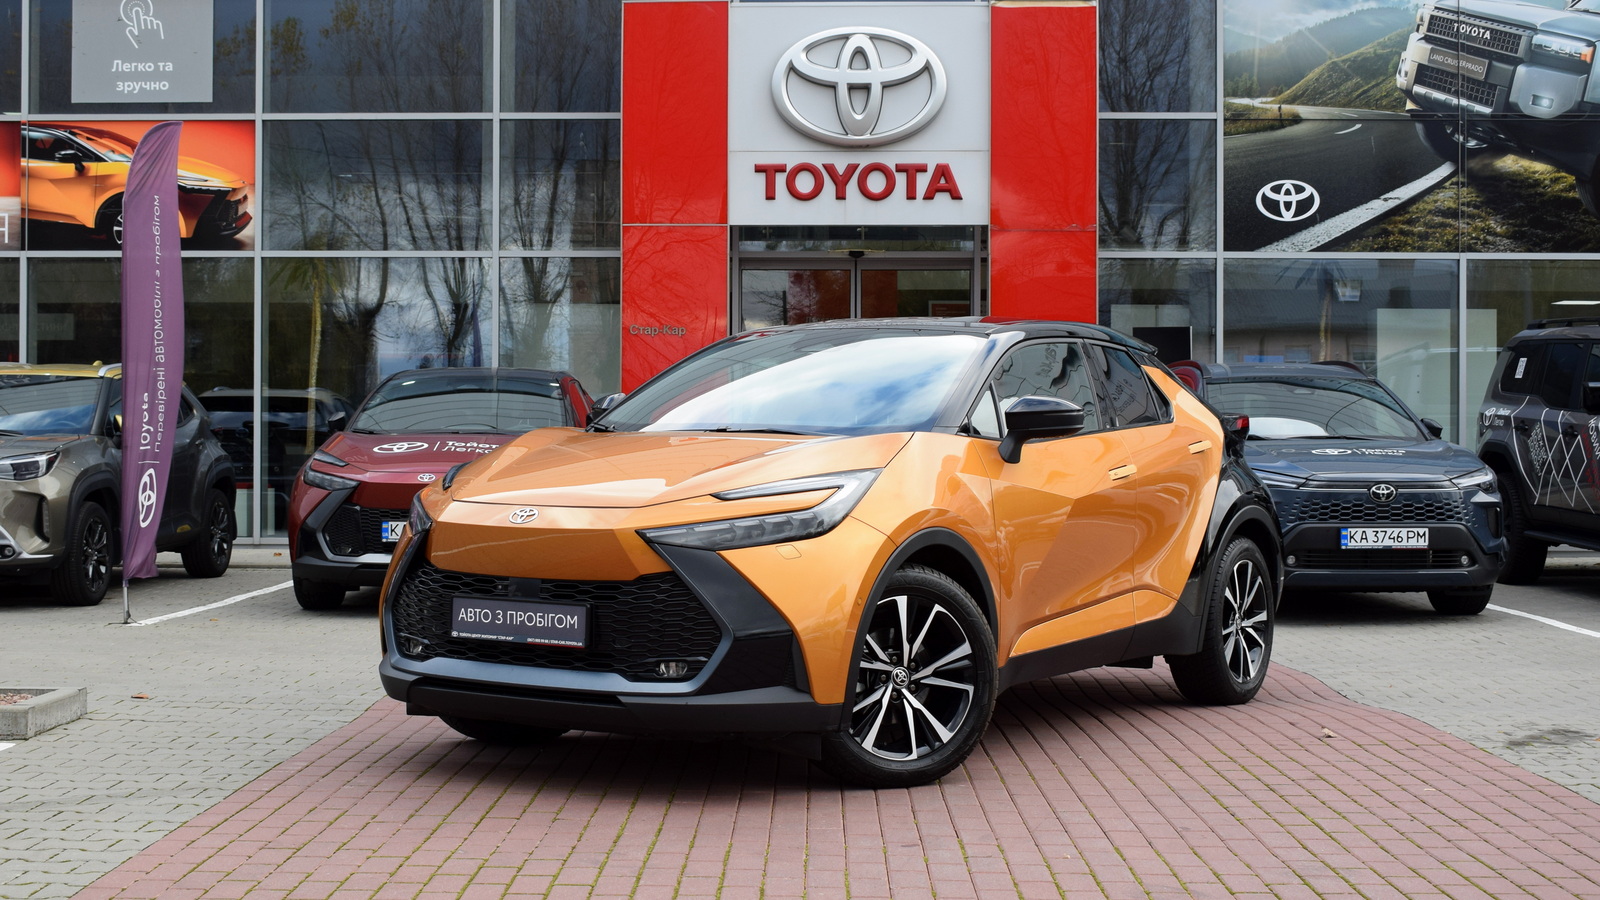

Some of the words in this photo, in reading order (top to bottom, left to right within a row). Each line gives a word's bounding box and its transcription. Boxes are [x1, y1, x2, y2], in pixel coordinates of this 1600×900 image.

[1454, 23, 1490, 39] TOYOTA
[1430, 53, 1443, 62] LAND
[111, 60, 155, 72] Легко
[157, 62, 173, 72] та
[116, 81, 169, 93] зручно
[754, 162, 963, 201] TOYOTA
[152, 195, 161, 264] пробігом
[629, 324, 687, 337] Стар-Кар
[153, 367, 167, 452] Перевірені
[1349, 530, 1369, 544] KA
[1372, 530, 1404, 544] 3746
[1406, 530, 1427, 544] PM
[458, 608, 492, 623] АВТО
[507, 611, 578, 629] ПРОБІГОМ
